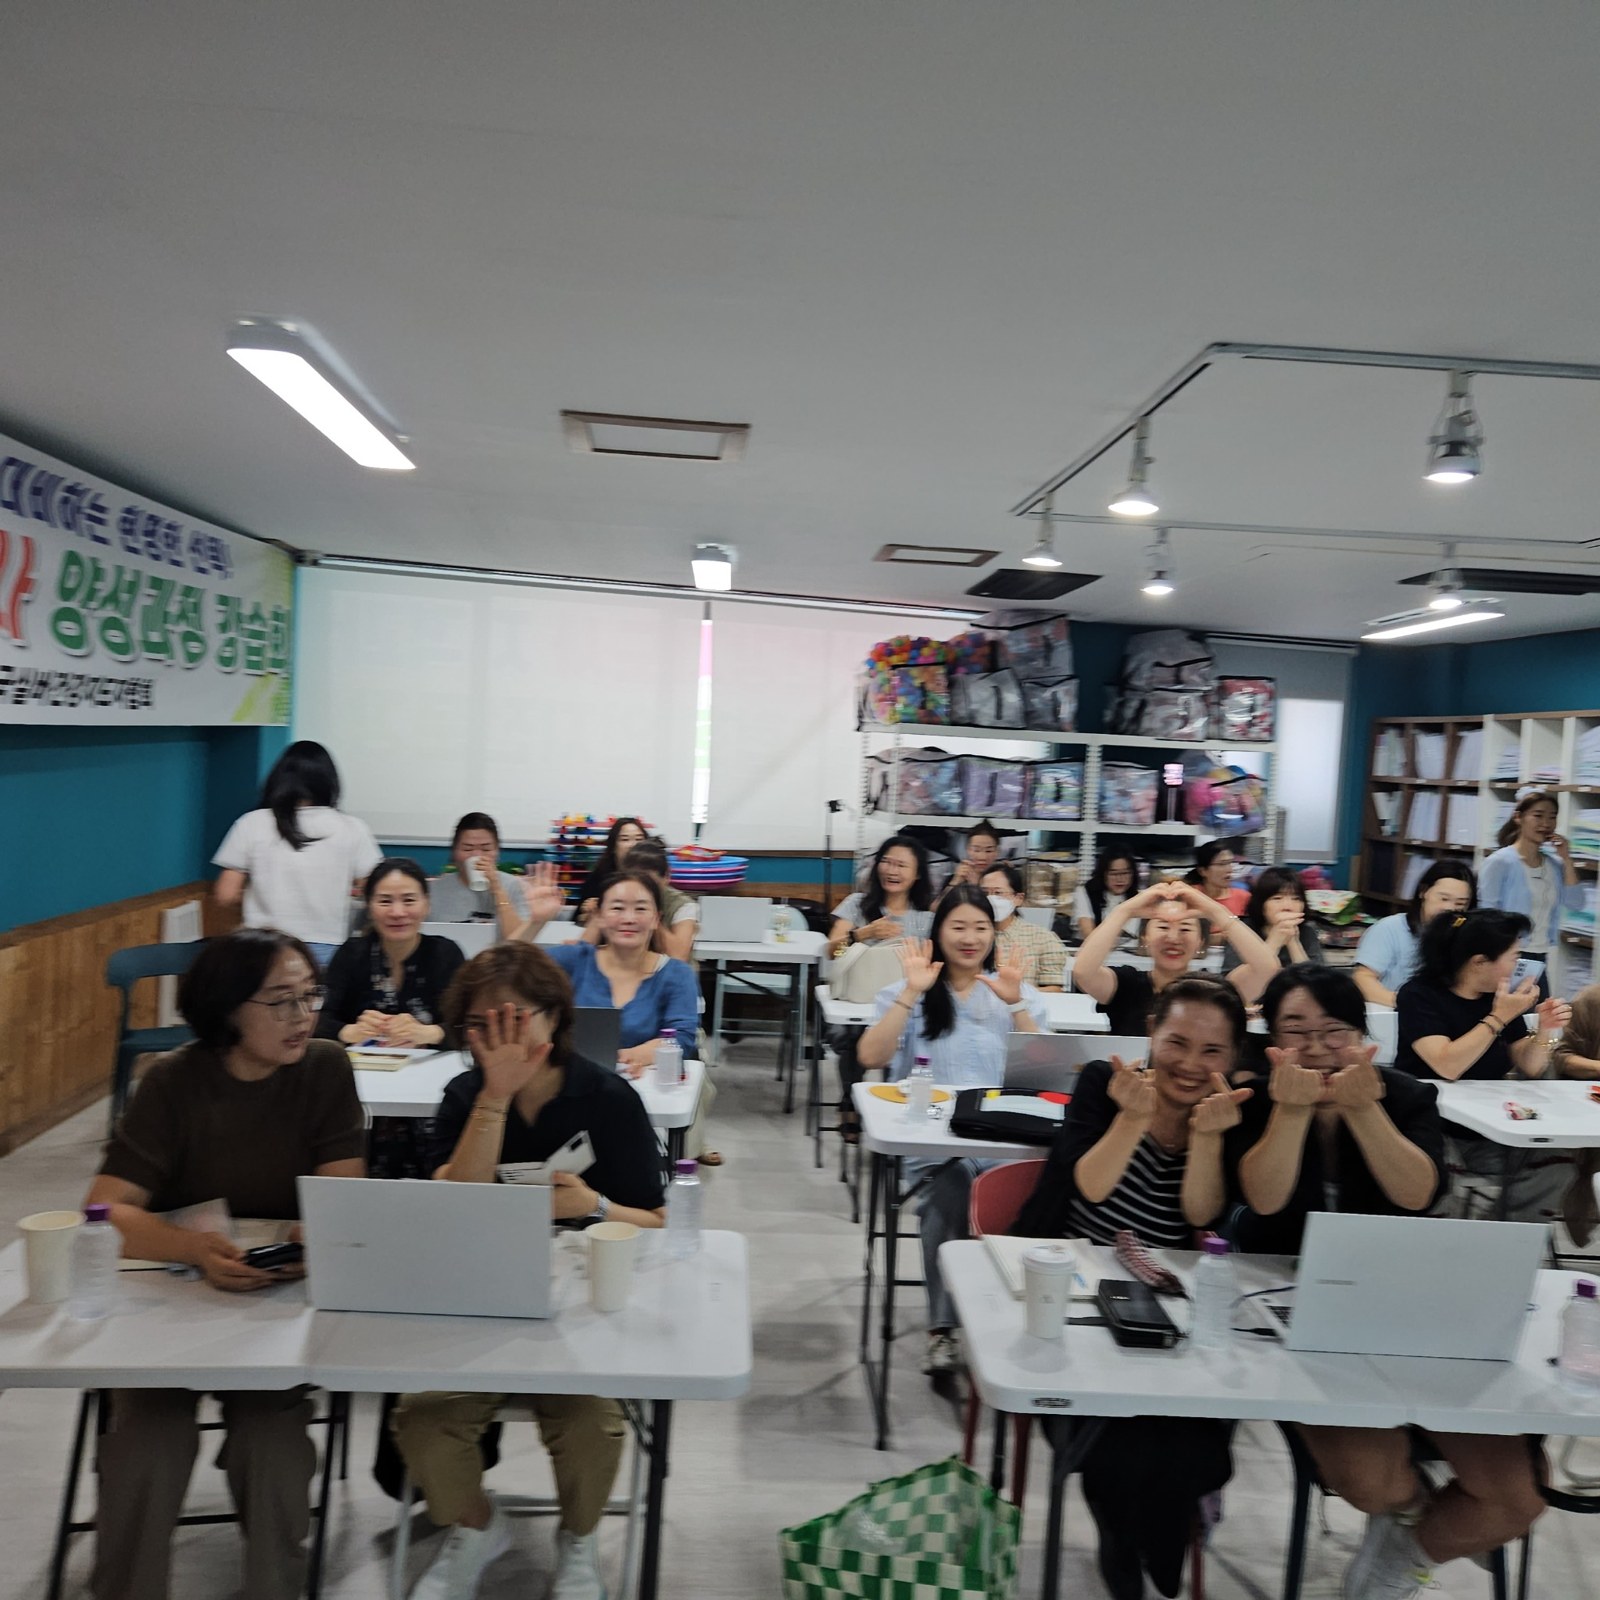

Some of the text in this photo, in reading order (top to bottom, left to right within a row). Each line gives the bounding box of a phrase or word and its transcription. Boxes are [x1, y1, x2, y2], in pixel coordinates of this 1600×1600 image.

[188, 531, 234, 579] 선택
[51, 550, 207, 665] 양성과정
[215, 594, 289, 675] 강습회
